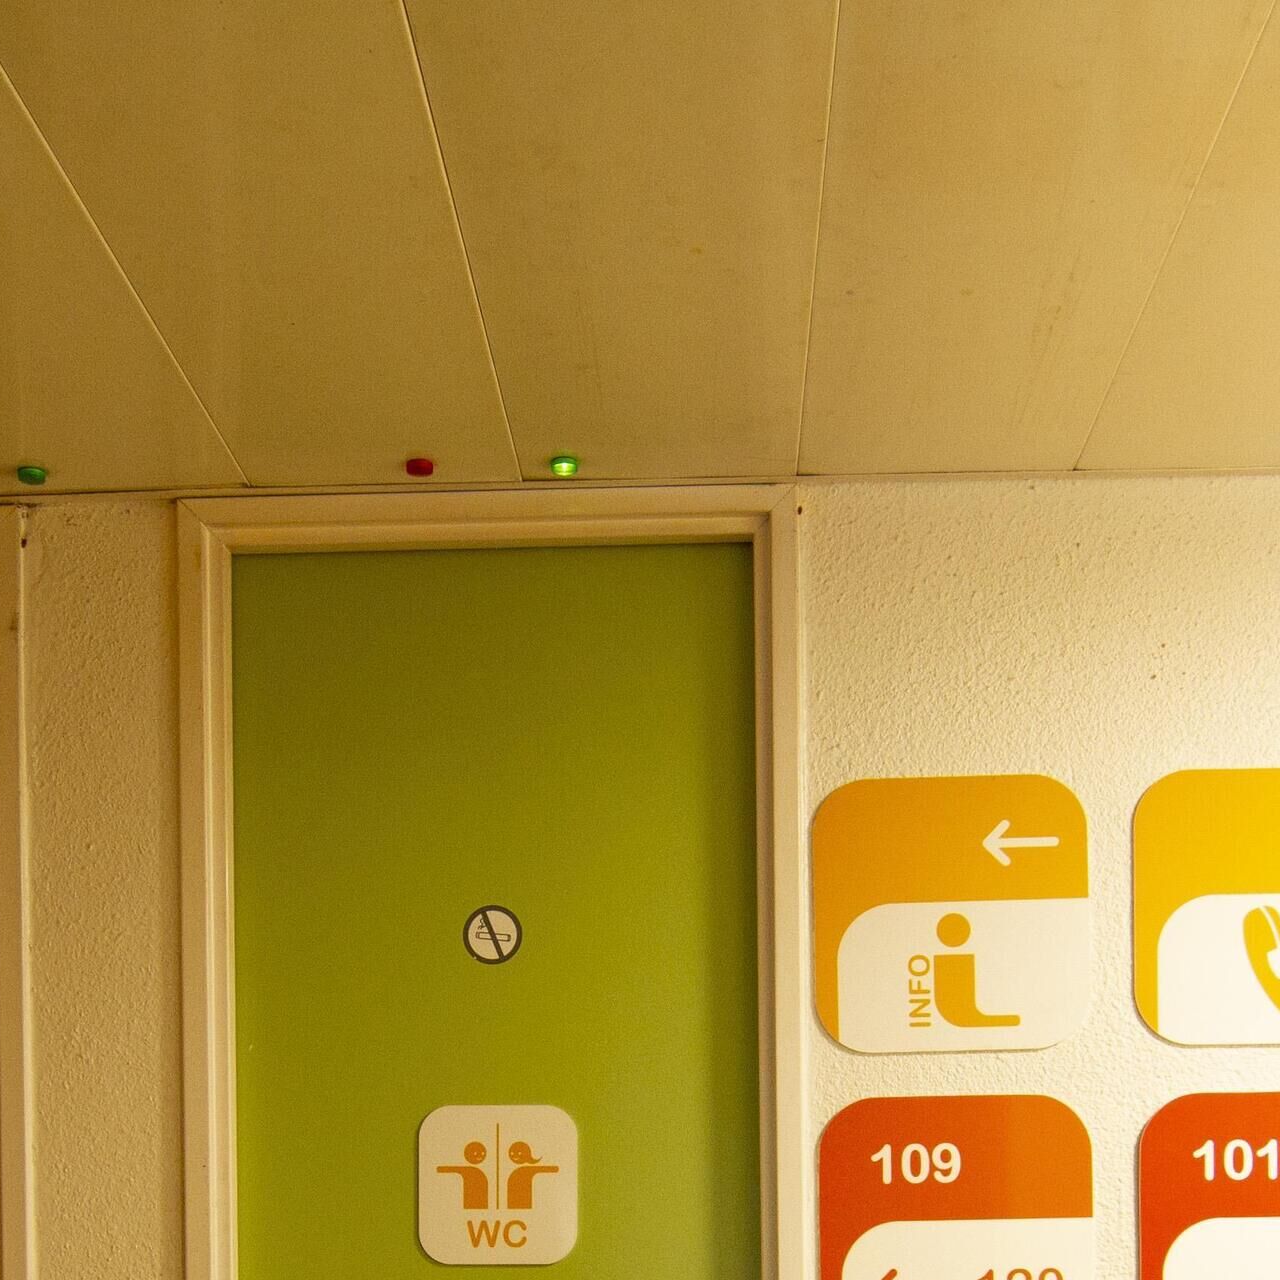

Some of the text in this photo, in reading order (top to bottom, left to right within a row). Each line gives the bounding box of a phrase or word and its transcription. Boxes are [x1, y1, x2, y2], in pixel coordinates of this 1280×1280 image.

[908, 954, 931, 1027] INFO
[870, 1142, 961, 1185] 109
[1193, 1139, 1280, 1181] 101
[466, 1219, 528, 1249] WC
